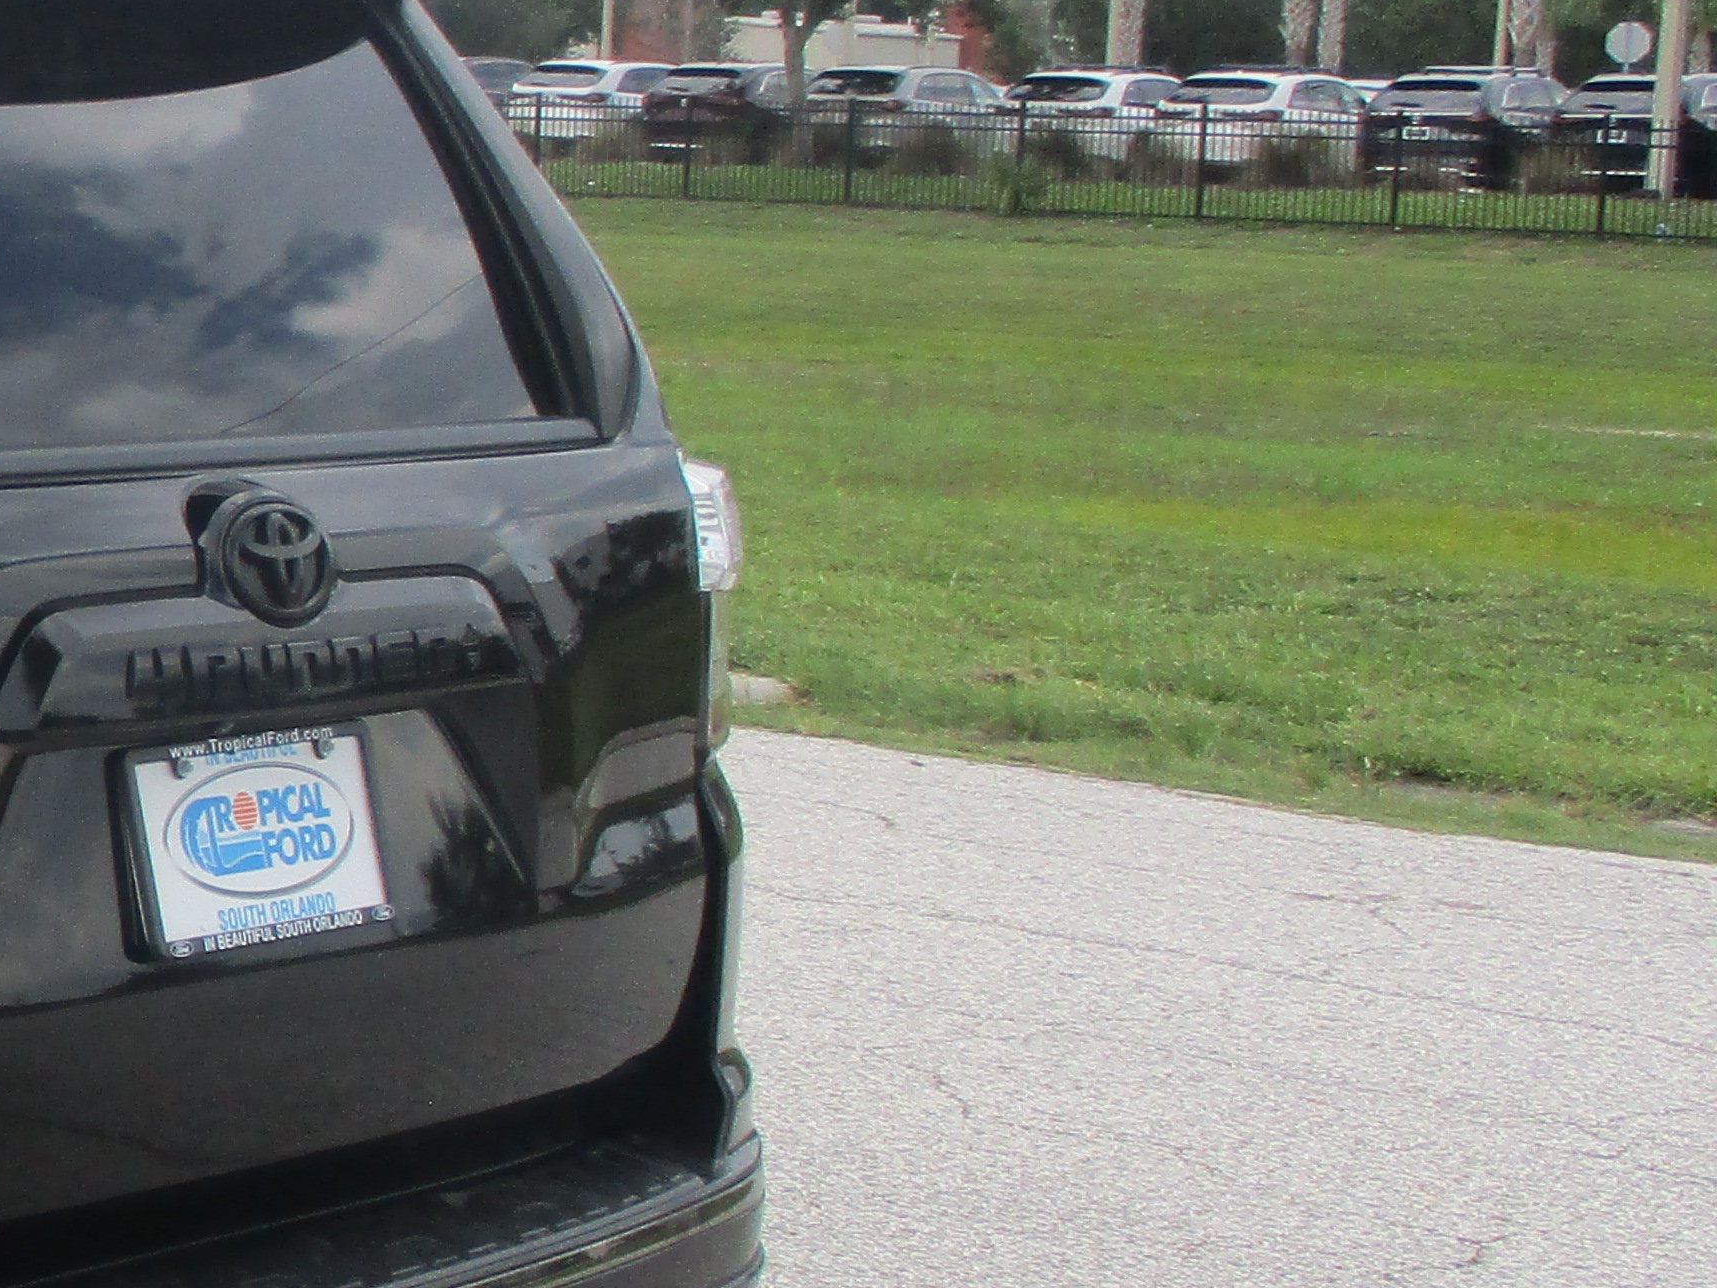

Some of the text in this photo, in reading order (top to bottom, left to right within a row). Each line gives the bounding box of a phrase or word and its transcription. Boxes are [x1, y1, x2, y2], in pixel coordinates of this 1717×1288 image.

[168, 726, 333, 759] www.TropicalFord.com
[181, 782, 332, 854] TROPICAL
[264, 823, 336, 867] FORD
[203, 934, 217, 952] IN
[217, 926, 276, 950] BEAUTIFUL
[276, 919, 312, 939] SOUTH
[313, 910, 363, 932] ORLANDO
[218, 902, 267, 931] SOUTH
[270, 891, 336, 922] ORLANDO
